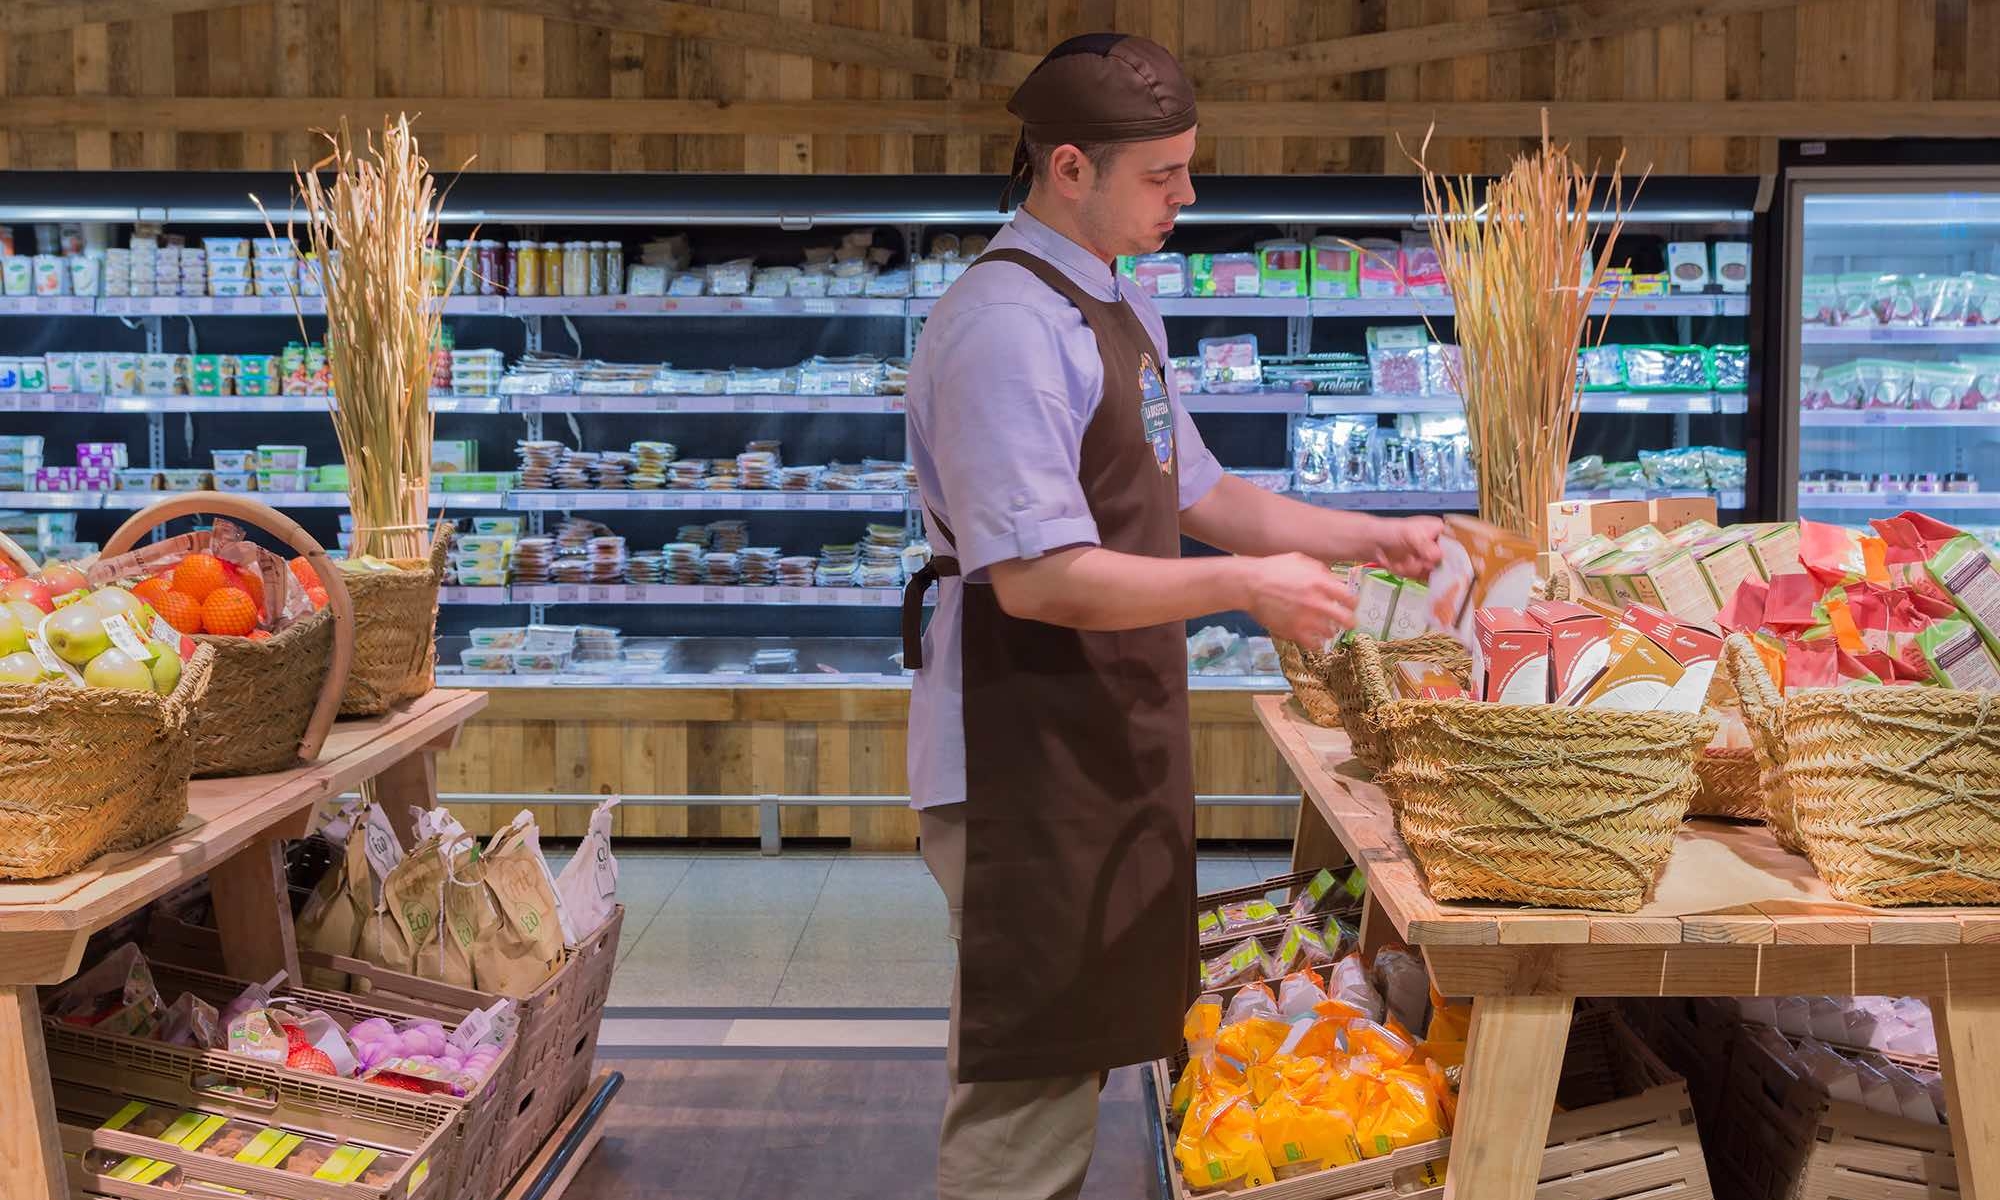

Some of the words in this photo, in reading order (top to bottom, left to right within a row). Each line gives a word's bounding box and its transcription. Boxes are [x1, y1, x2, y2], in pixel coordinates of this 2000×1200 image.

[371, 836, 388, 854] Eco
[406, 912, 430, 932] Eco
[520, 911, 540, 934] Eco
